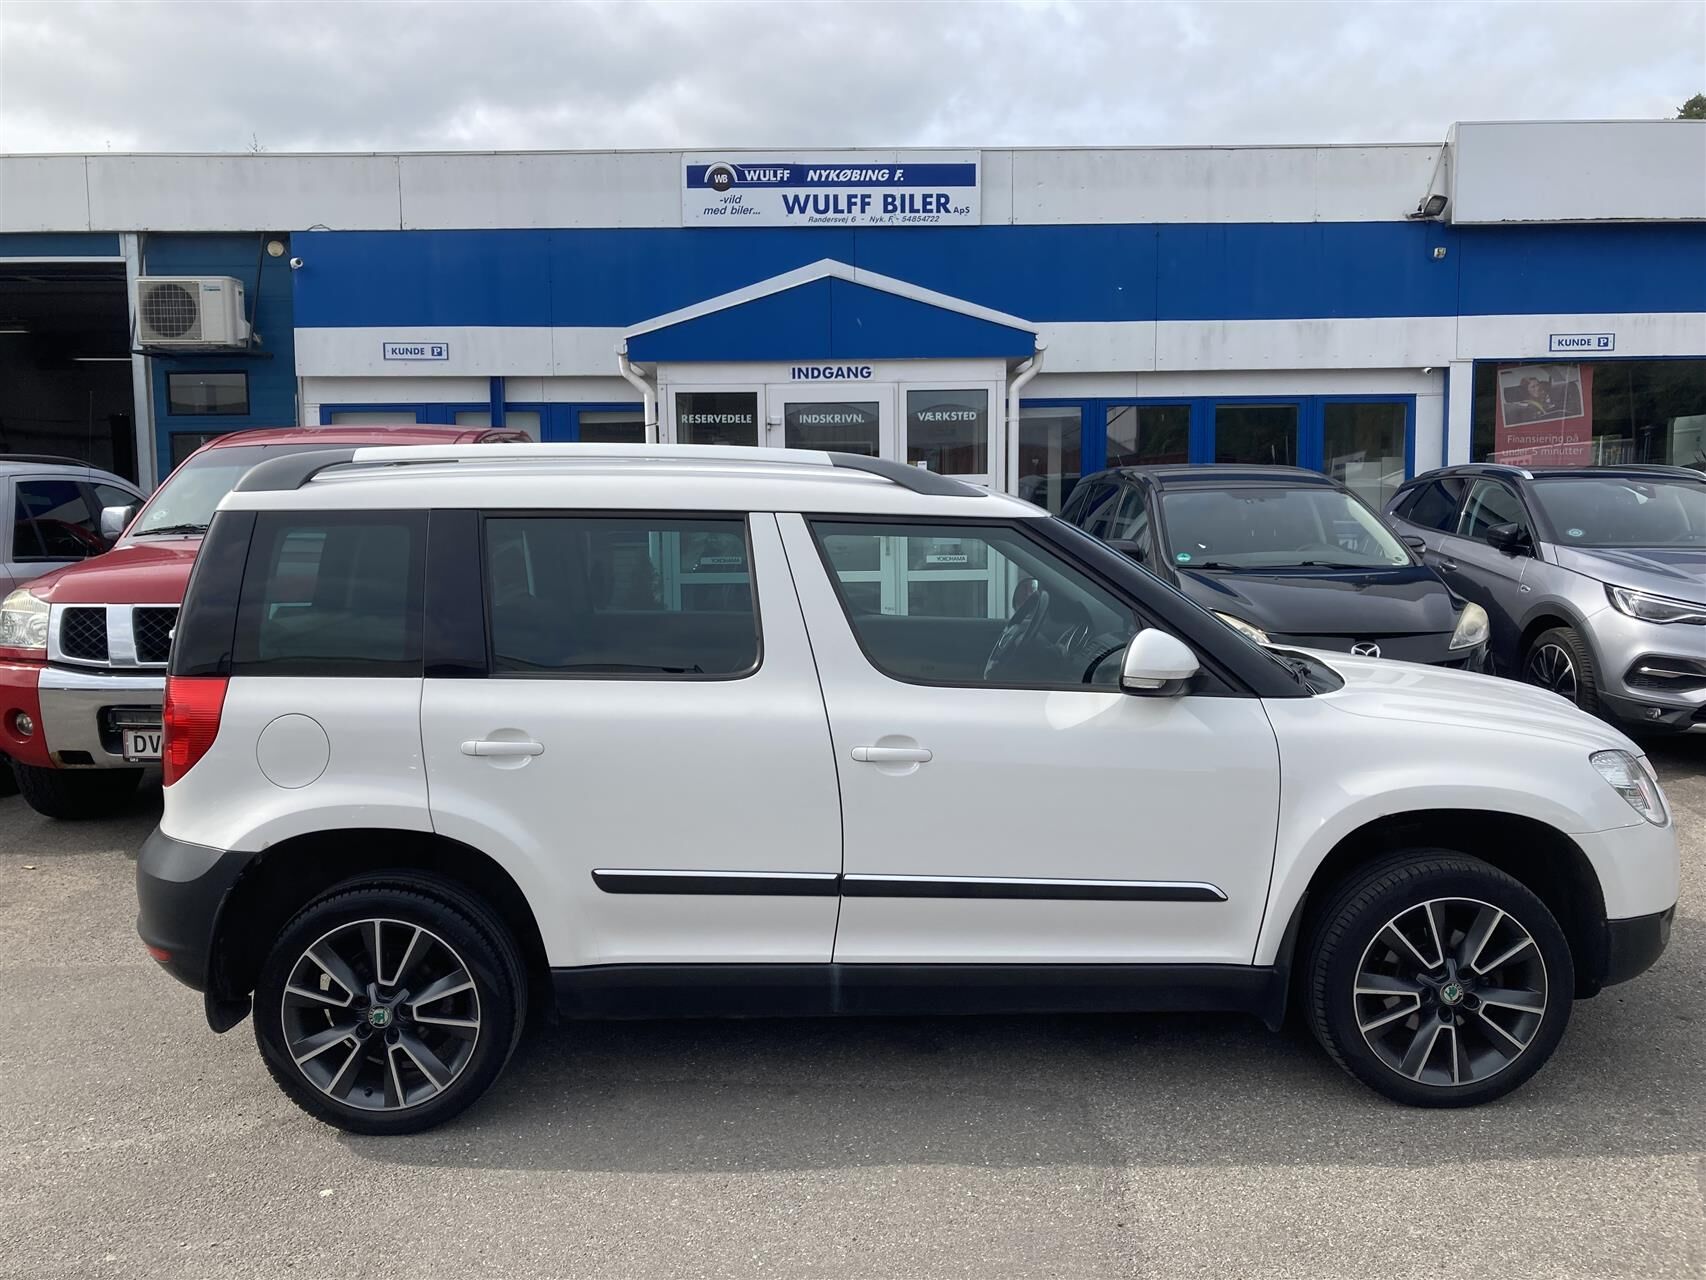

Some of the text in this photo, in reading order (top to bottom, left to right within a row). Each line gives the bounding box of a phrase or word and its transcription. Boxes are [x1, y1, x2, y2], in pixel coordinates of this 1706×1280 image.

[714, 174, 728, 183] WB
[744, 169, 791, 181] WULFF
[807, 169, 904, 181] NYKØBING F.
[719, 195, 742, 204] -vild
[781, 193, 970, 216] WULFF BILER ApS
[703, 206, 761, 215] med biler...
[902, 215, 940, 223] 54854722
[1558, 338, 1592, 347] KUNDE
[391, 347, 425, 355] KUNDE
[791, 366, 872, 380] INDGANG
[681, 414, 752, 424] RESERVEDELE
[799, 414, 865, 424] INDSKRIVN.
[918, 411, 977, 422] VÆRKSTED
[1507, 434, 1564, 445] Finansiering
[1540, 448, 1584, 456] minutter
